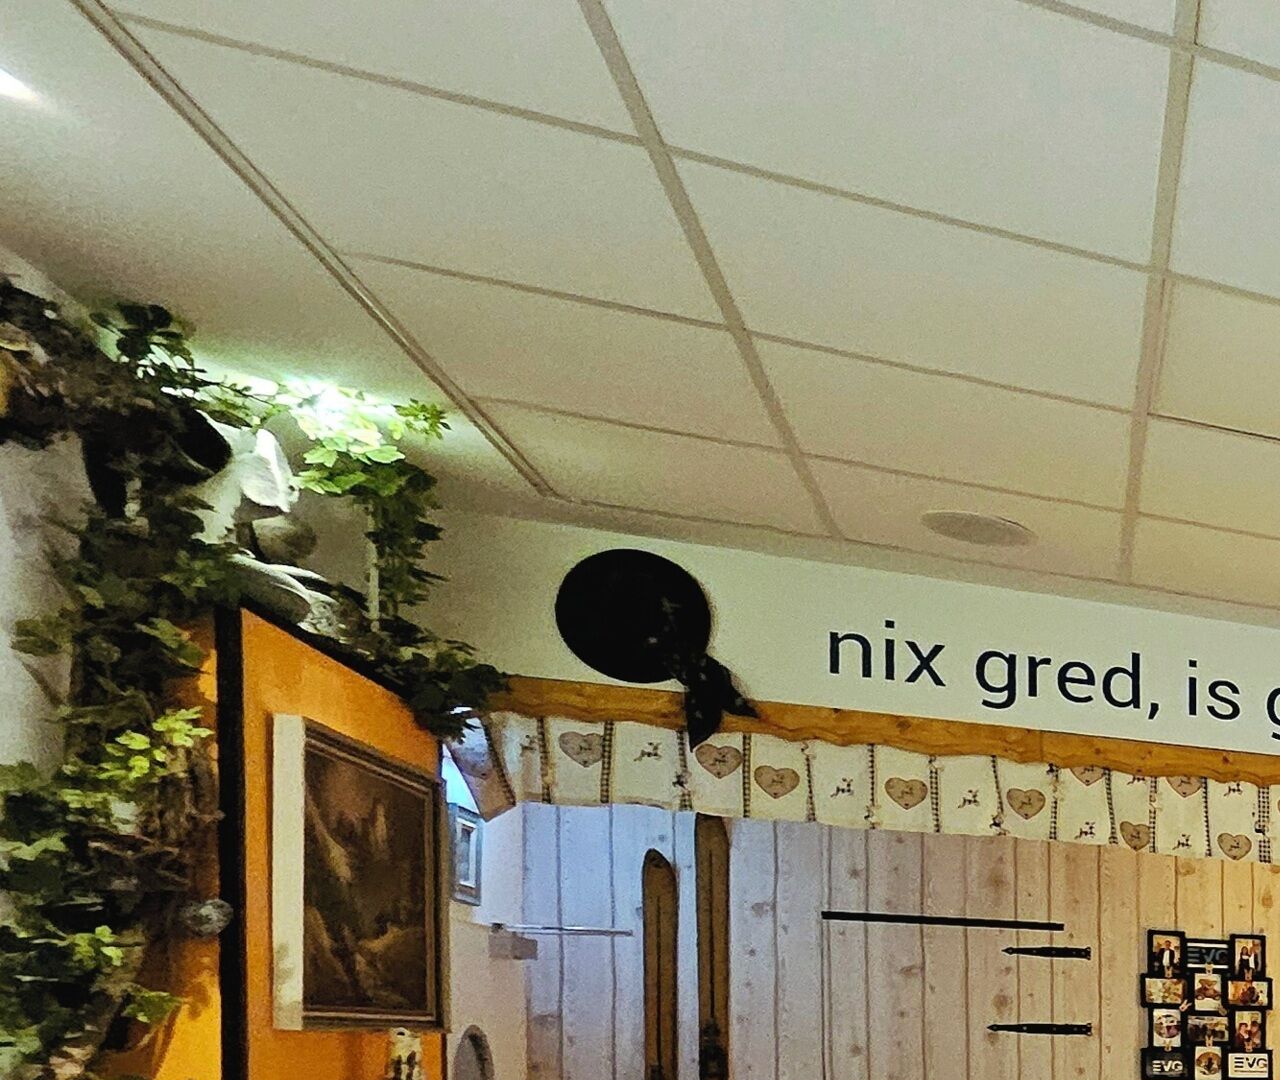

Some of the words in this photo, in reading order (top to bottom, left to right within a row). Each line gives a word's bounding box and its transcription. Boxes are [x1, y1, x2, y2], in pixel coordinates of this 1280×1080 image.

[829, 619, 946, 687] nix
[975, 650, 1160, 720] gred,
[1188, 659, 1241, 721] is
[1152, 1059, 1184, 1072] EVG
